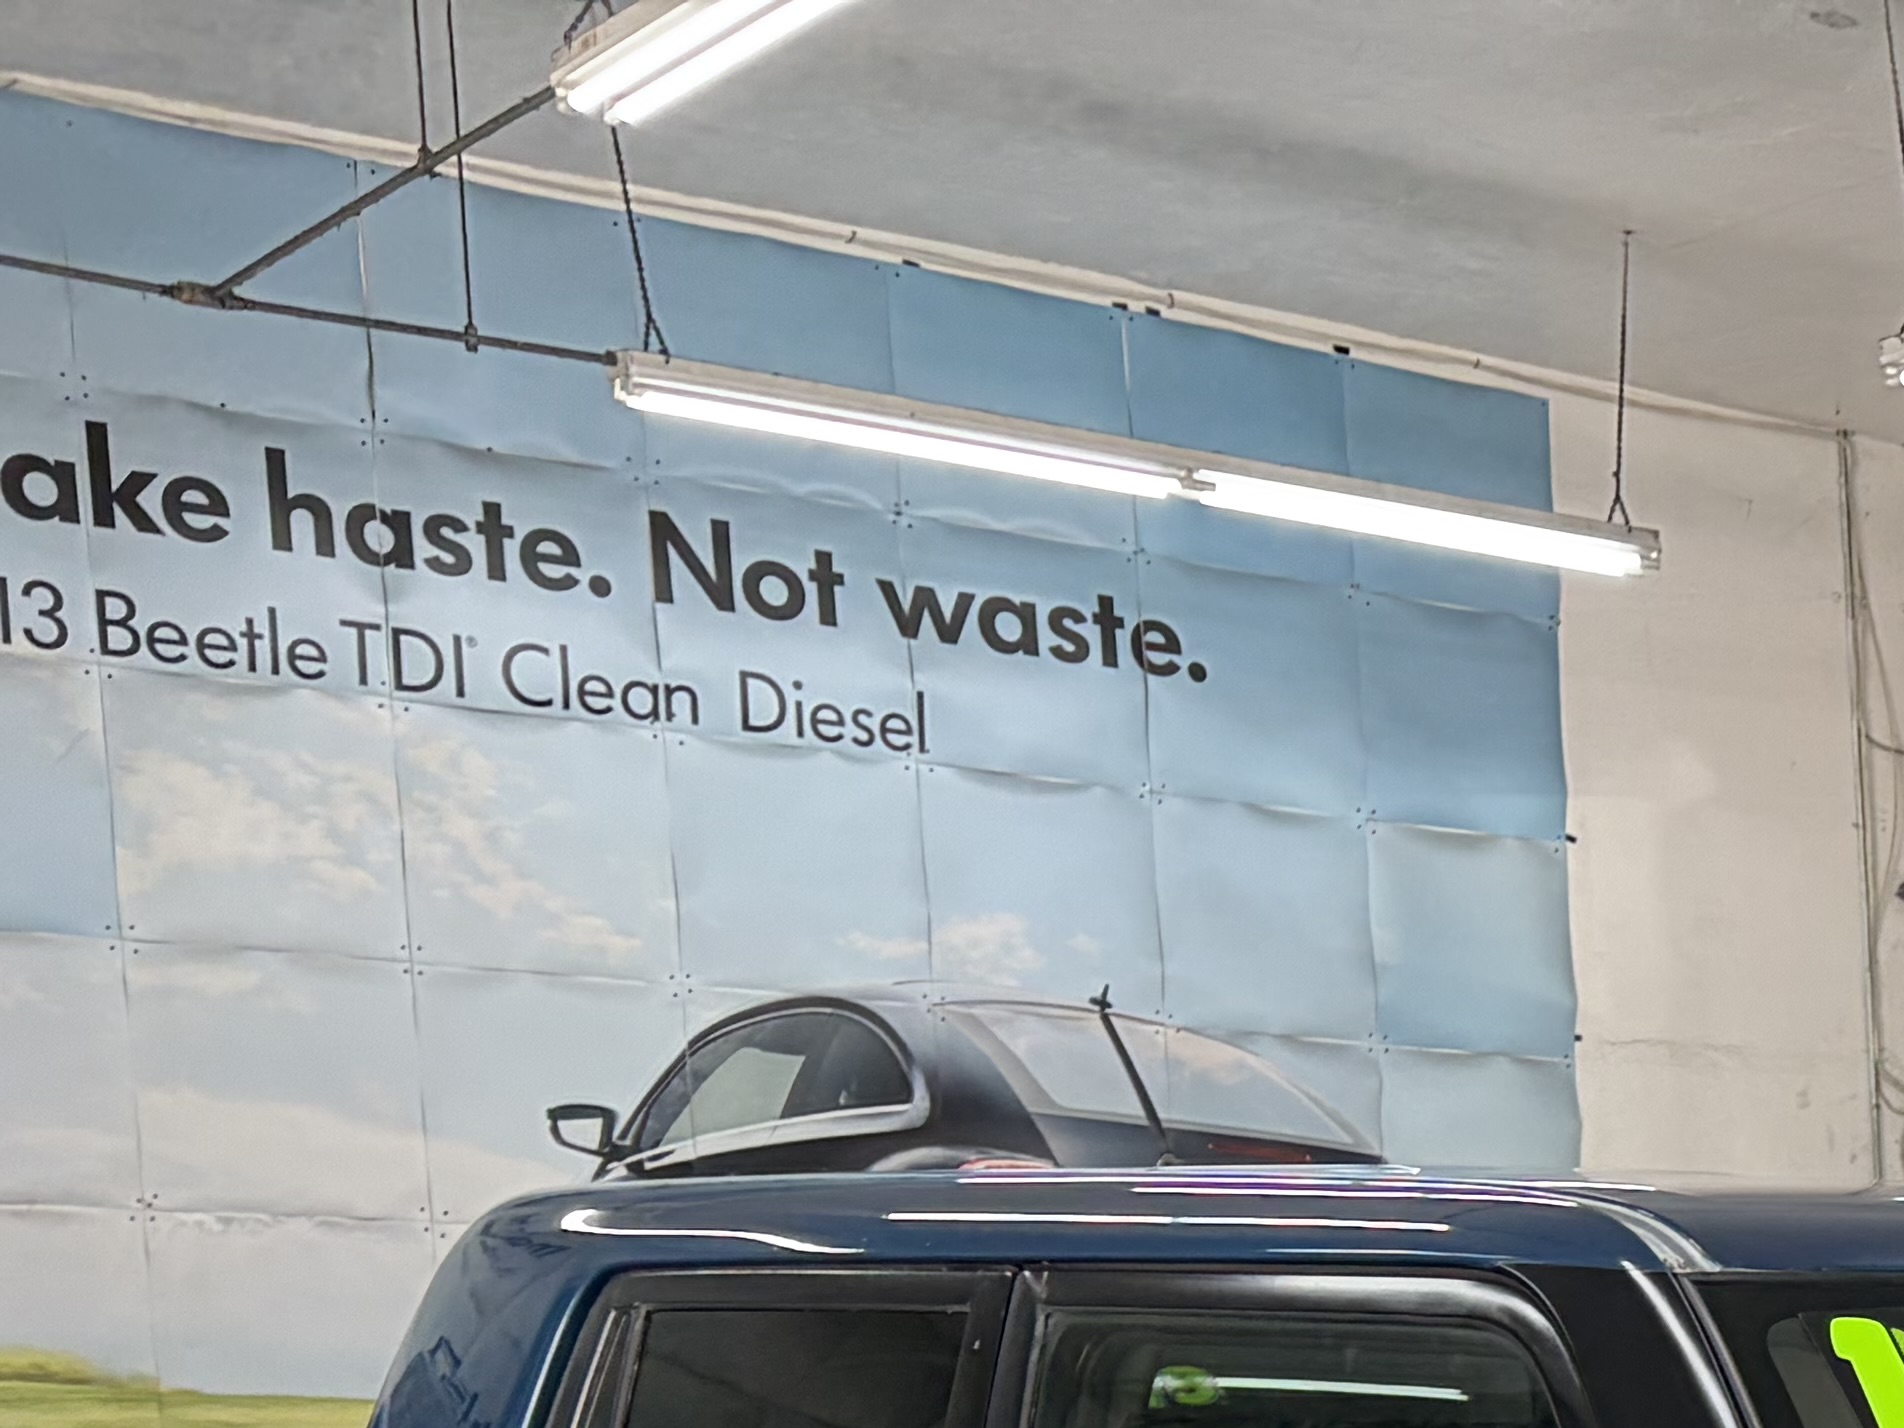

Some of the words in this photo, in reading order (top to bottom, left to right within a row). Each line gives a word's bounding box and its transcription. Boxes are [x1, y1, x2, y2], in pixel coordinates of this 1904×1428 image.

[0, 420, 230, 544] ake
[264, 446, 614, 599] haste.
[648, 509, 845, 627] Not
[875, 578, 1208, 683] waste.
[94, 588, 328, 681] Beetle
[502, 642, 699, 726] Clean
[738, 670, 928, 754] Diesel
